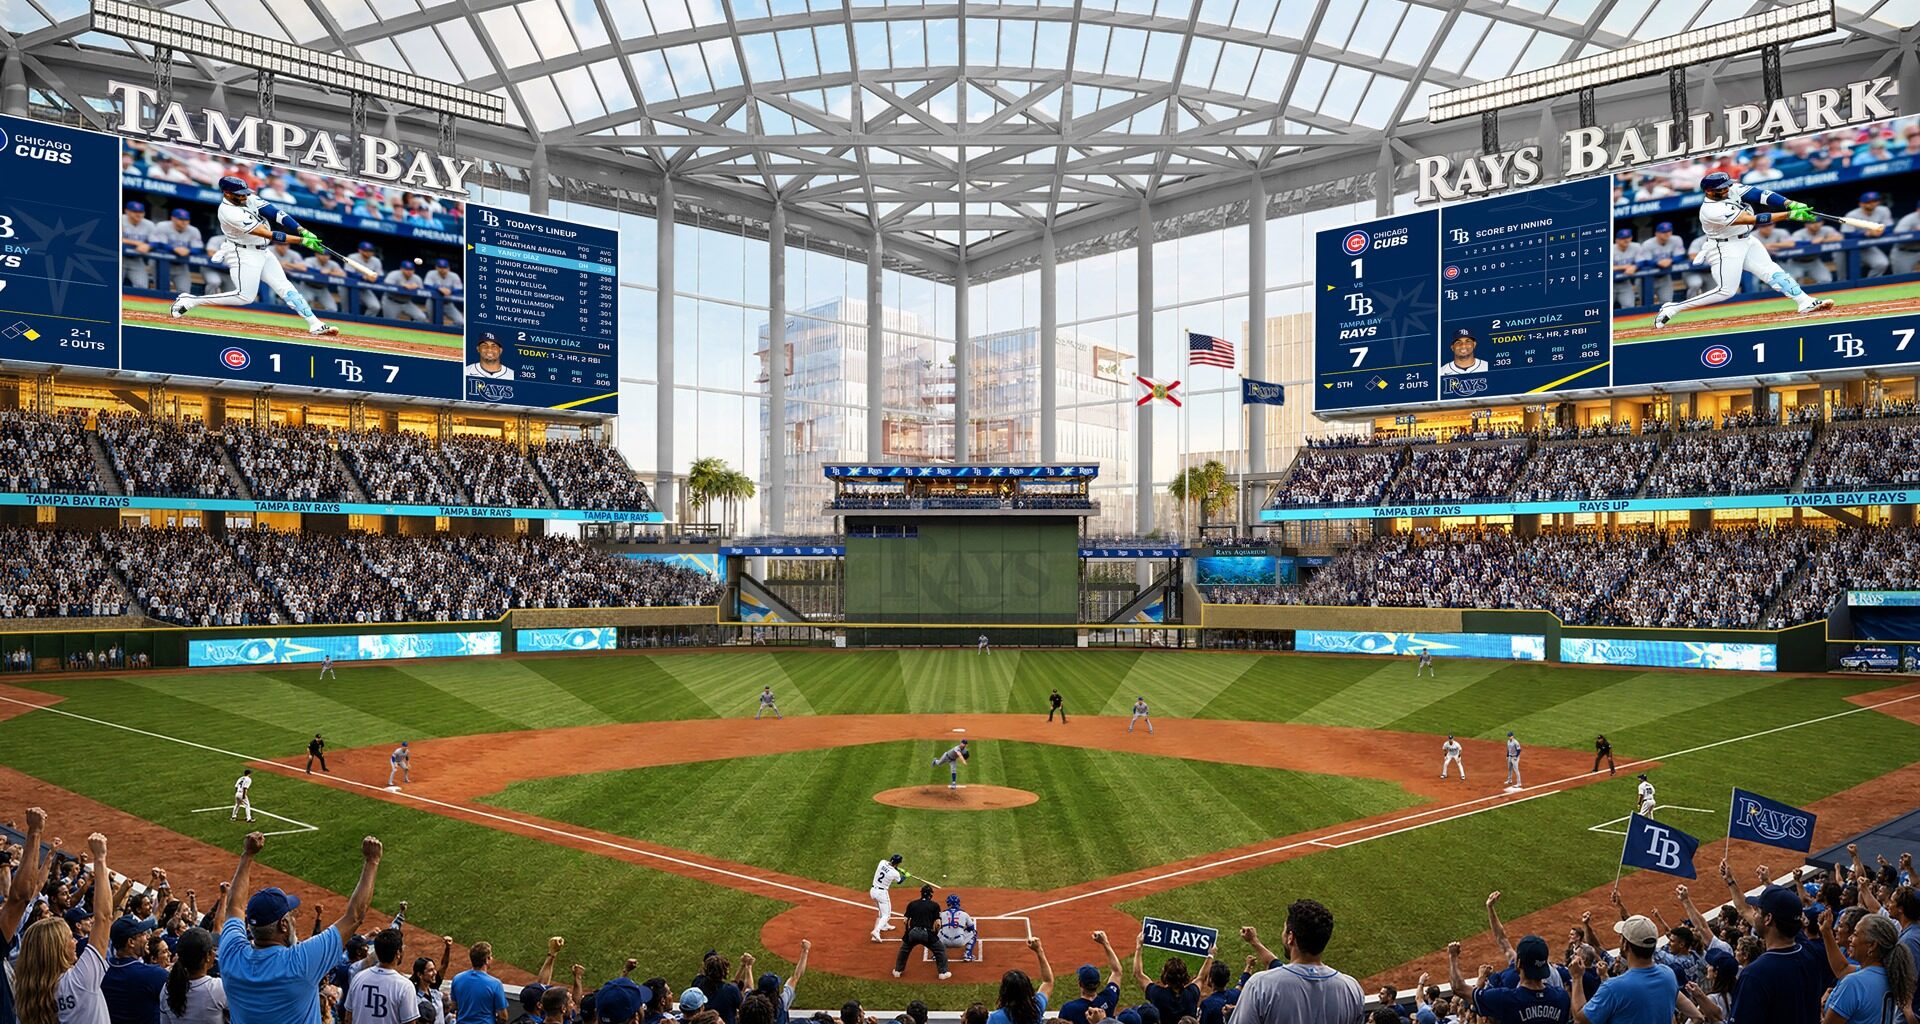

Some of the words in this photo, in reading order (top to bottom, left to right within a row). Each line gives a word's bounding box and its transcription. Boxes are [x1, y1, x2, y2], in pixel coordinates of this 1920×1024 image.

[15, 134, 71, 151] CHICAGO
[108, 80, 347, 172] TAMPA
[359, 134, 475, 195] BAY
[1414, 146, 1540, 203] RAYS
[1565, 75, 1897, 176] BALLPARK
[15, 144, 73, 164] CUBS
[479, 210, 499, 227] TB
[506, 219, 544, 232] TODAY'S
[546, 227, 577, 238] LINEUP
[495, 232, 519, 240] PLAYER
[1374, 227, 1408, 239] CHICAGO
[1450, 228, 1469, 244] TB
[1476, 226, 1505, 238] SCORE
[1507, 224, 1519, 232] BY
[1520, 219, 1553, 230] INNING
[497, 240, 537, 251] JONATHAN
[538, 246, 567, 256] ARANDA
[1374, 235, 1408, 249] CUBS
[5, 245, 30, 255] BAY
[497, 249, 522, 258] YANDY
[495, 260, 521, 269] JUNIOR
[522, 264, 558, 274] CAMINERO
[495, 268, 513, 277] RYAN
[1351, 258, 1362, 279] 1
[495, 278, 518, 286] JONNY
[520, 281, 547, 290] DELUCA
[495, 286, 532, 296] CHANDLER
[533, 292, 564, 301] SIMPSON
[495, 295, 510, 303] BEN
[511, 298, 554, 309] WILLIAMSON
[1344, 293, 1373, 316] TB
[495, 305, 521, 314] TAYLOR
[522, 309, 545, 317] WALLS
[513, 317, 540, 325] FORTES
[1339, 319, 1365, 329] TAMPA
[1367, 318, 1382, 326] BAY
[1492, 320, 1501, 329] 2
[1505, 318, 1537, 327] YANDY
[1539, 313, 1563, 323] DÍAZ
[1584, 309, 1599, 317] DH
[71, 328, 91, 338] 2-1
[517, 332, 526, 341] 2
[530, 335, 558, 345] YANDY
[561, 338, 581, 348] DÍAZ
[1339, 326, 1377, 340] RAYS
[1492, 335, 1526, 344] TODAY:
[1546, 330, 1562, 338] HR,
[60, 339, 68, 347] 2
[71, 339, 105, 350] OUTS
[1753, 343, 1765, 363] 1
[1828, 333, 1865, 358] TB
[1892, 329, 1915, 351] 7
[518, 349, 549, 358] TODAY:
[1349, 347, 1368, 368] 7
[270, 354, 281, 373] 1
[335, 359, 363, 383] TB
[382, 365, 400, 383] 7
[1406, 373, 1420, 381] 2-1
[469, 378, 514, 401] RAYS
[1337, 381, 1353, 389] 5TH
[1407, 381, 1429, 389] OUTS
[1443, 377, 1488, 396] RAYS
[26, 495, 70, 506] TAMPA
[72, 496, 96, 506] BAY
[99, 496, 130, 507] RAYS
[1579, 501, 1609, 511] RAYS
[1613, 500, 1629, 511] UP
[1784, 494, 1834, 506] TAMPA
[1836, 493, 1866, 504] BAY
[1868, 492, 1907, 503] RAYS
[254, 501, 290, 512] TAMPA
[292, 502, 312, 512] BAY
[314, 503, 340, 513] RAYS
[439, 507, 470, 516] TAMPA
[472, 507, 488, 517] BAY
[490, 508, 512, 517] RAYS
[1373, 507, 1408, 517] TAMPA
[1410, 506, 1431, 516] BAY
[1433, 506, 1461, 515] RAYS
[584, 511, 613, 521] TAMPA
[614, 512, 629, 521] BAY
[630, 512, 649, 522] RAYS
[1737, 797, 1807, 840] RAYS
[1644, 824, 1680, 869] TB
[878, 872, 885, 883] 2
[1146, 923, 1161, 942] TB
[1170, 930, 1209, 949] RAYS
[361, 984, 387, 1017] TB
[1519, 1005, 1561, 1021] LONGORIA
